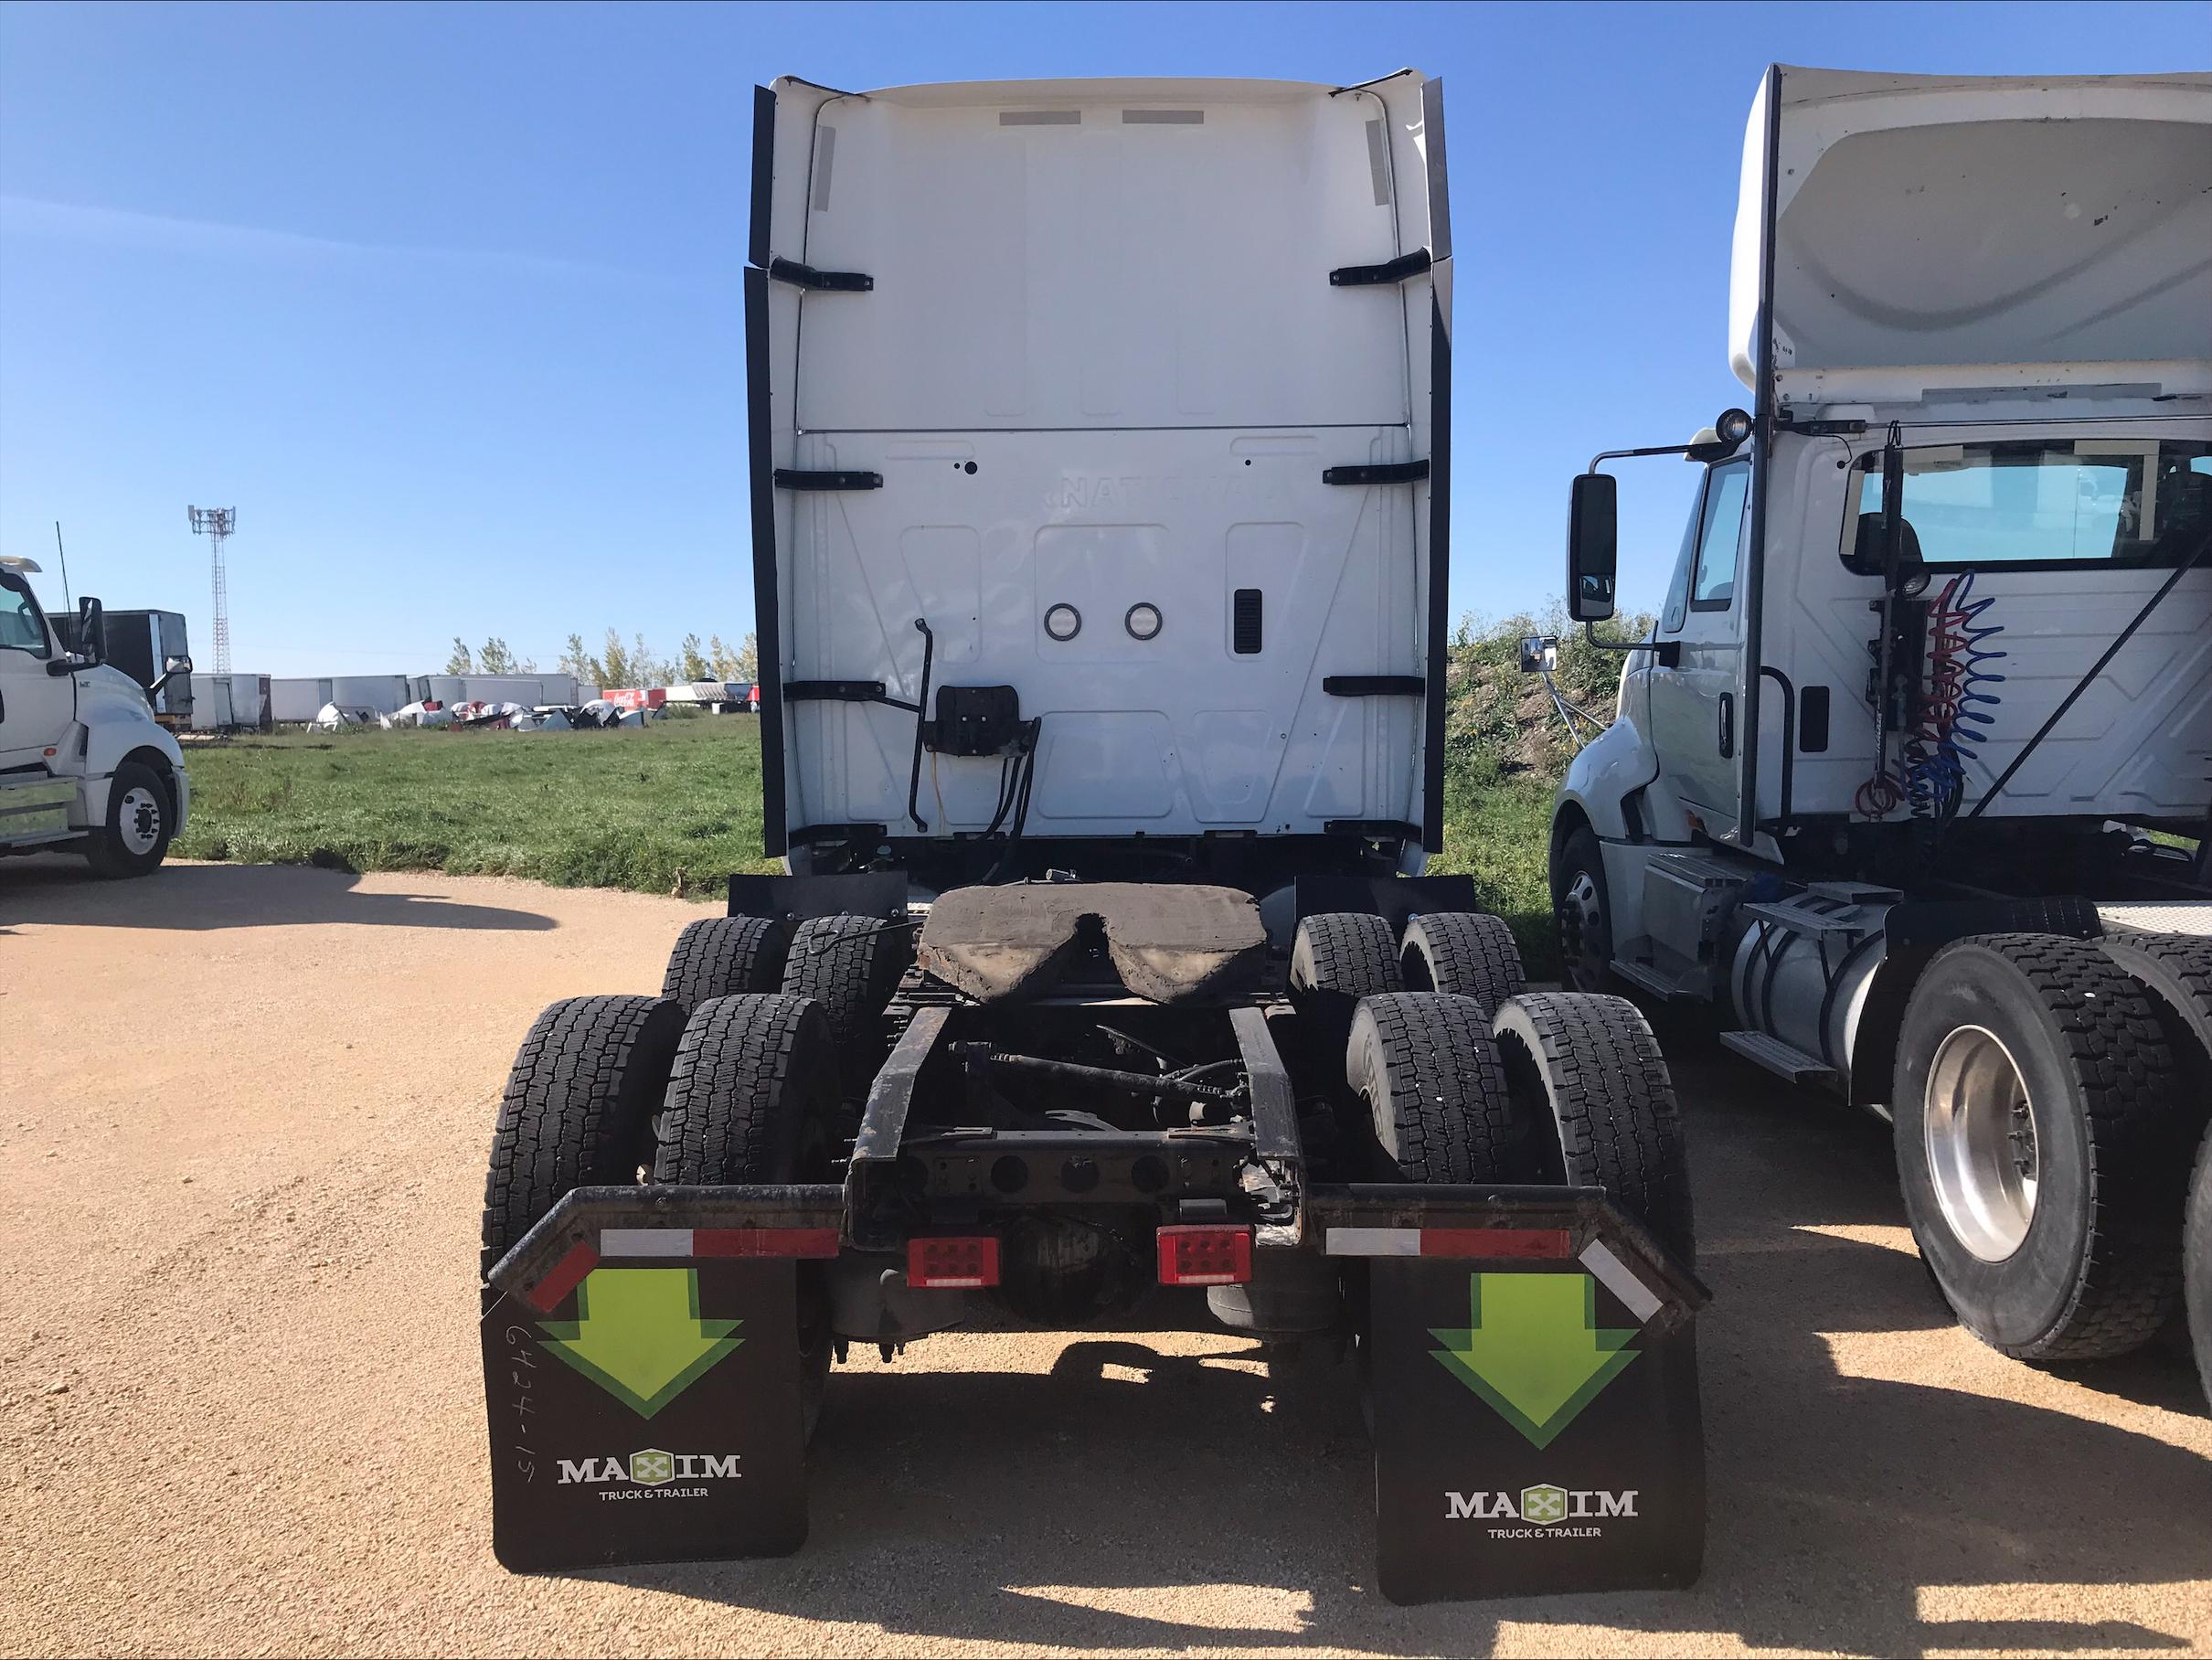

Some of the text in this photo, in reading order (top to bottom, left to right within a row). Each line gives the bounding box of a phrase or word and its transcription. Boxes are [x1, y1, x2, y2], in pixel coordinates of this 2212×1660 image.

[556, 1450, 742, 1485] MAXIM
[599, 1487, 709, 1501] TRUCK & TRAILER
[1444, 1485, 1639, 1523] MAXIM
[1488, 1527, 1602, 1539] TRUCK & TRAILER
